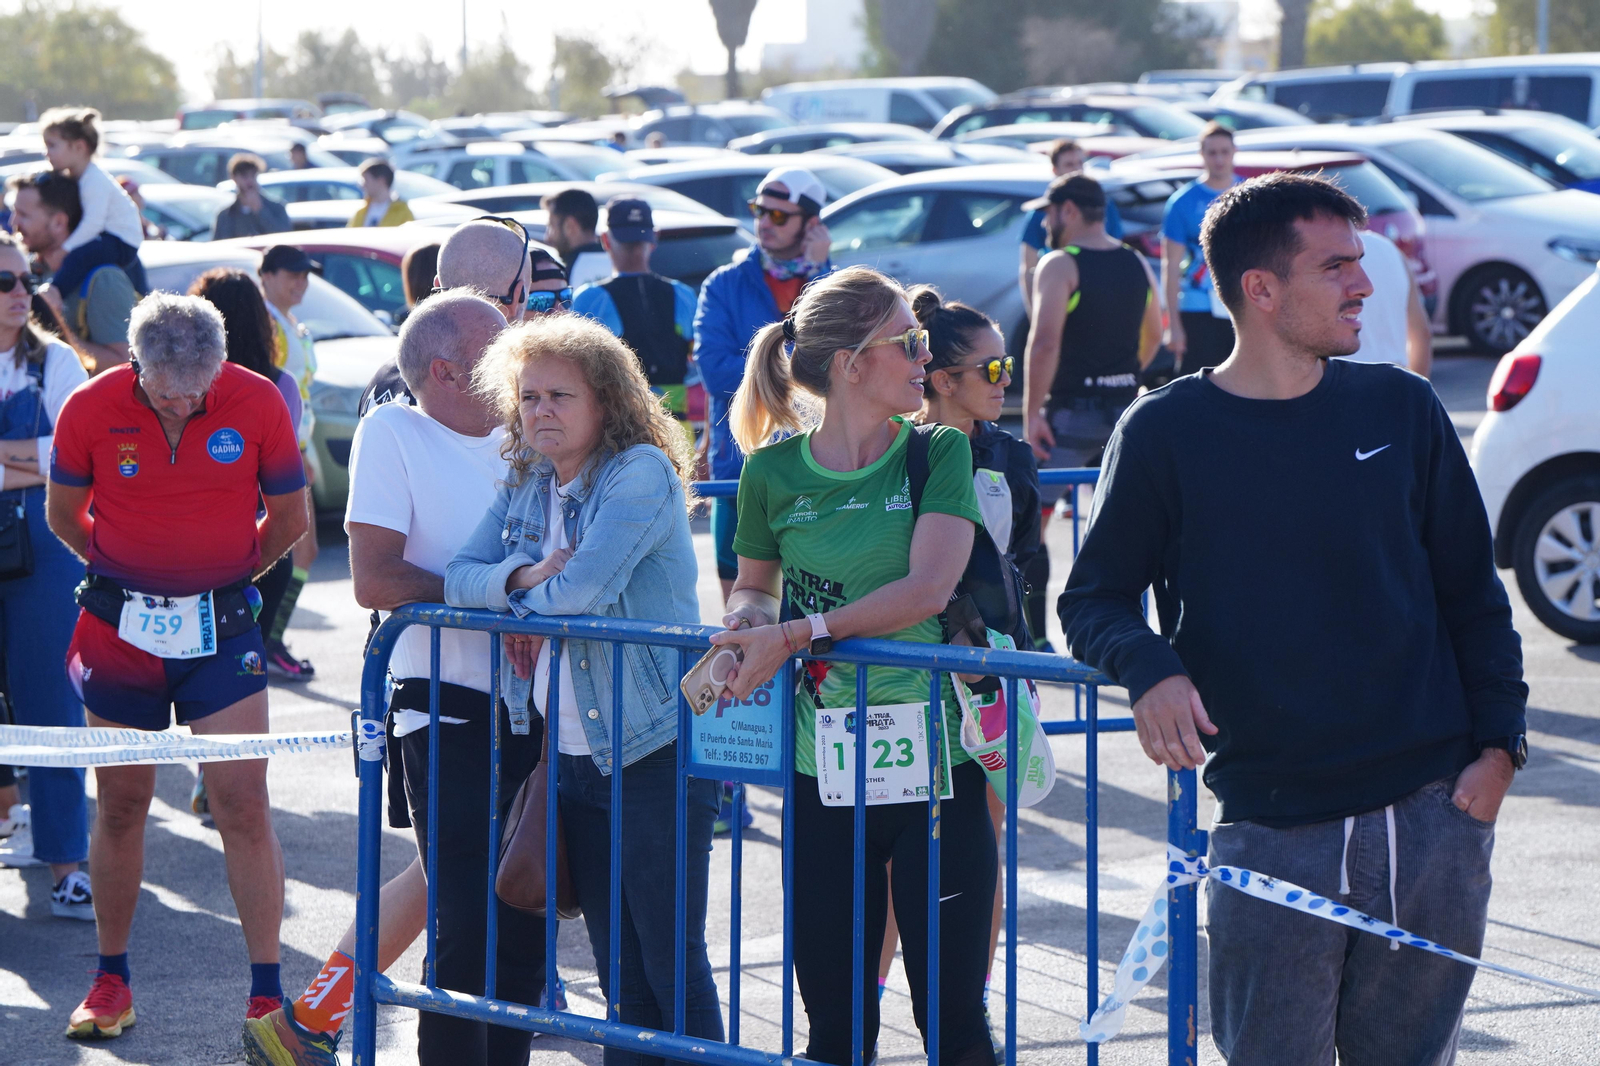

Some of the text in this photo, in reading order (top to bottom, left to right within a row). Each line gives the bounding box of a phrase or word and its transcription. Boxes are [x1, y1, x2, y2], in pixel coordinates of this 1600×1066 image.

[212, 444, 241, 454] GADIRA
[139, 613, 182, 635] 759
[200, 592, 213, 651] PIRATILL
[820, 714, 832, 724] 10
[768, 724, 773, 734] 3
[700, 732, 706, 742] El
[707, 733, 727, 745] Puerto
[728, 735, 736, 746] de
[737, 736, 754, 747] Santa
[723, 750, 738, 763] 956
[739, 752, 753, 764] 852
[755, 754, 769, 766] 967
[833, 737, 915, 771] 123
